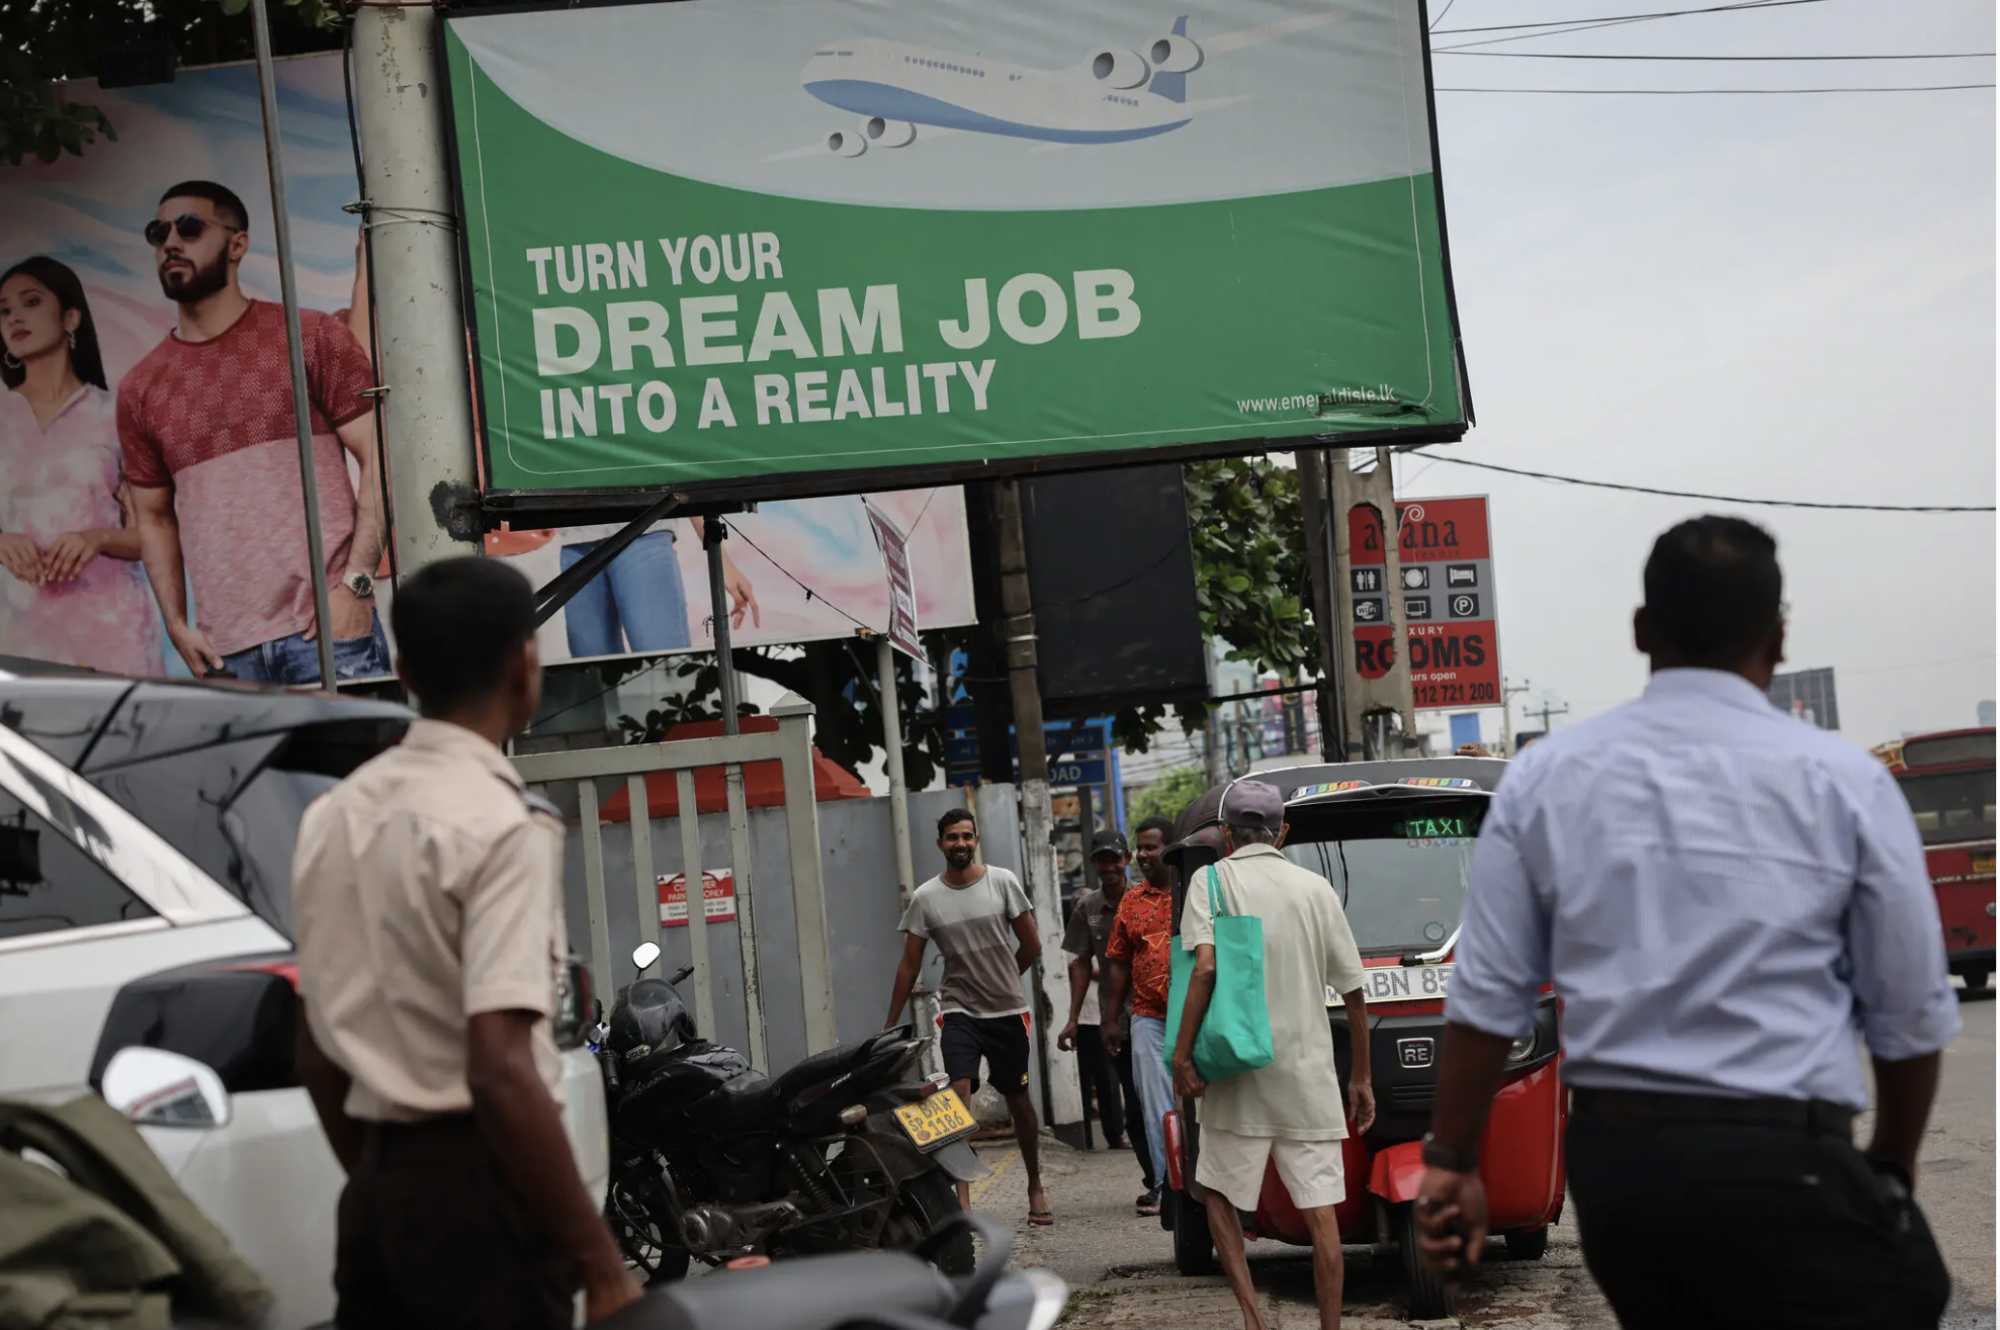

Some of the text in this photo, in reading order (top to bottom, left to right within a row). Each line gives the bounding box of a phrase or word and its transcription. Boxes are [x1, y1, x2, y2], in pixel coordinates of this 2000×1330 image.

[526, 231, 783, 295] TURN YOUR
[531, 268, 1141, 377] DREAM JOB
[540, 359, 997, 440] INTO A REALITY
[1236, 383, 1395, 413] www.emeraldisle.lk
[1409, 626, 1444, 635] XURY
[1410, 671, 1457, 683] urs open
[1414, 682, 1494, 703] 112 721 200
[1410, 819, 1462, 837] TAXI
[674, 881, 716, 892] CUMER
[704, 889, 724, 898] ONLY
[1404, 1047, 1428, 1062] RE
[918, 1093, 952, 1119] BAW
[928, 1110, 965, 1136] 1186
